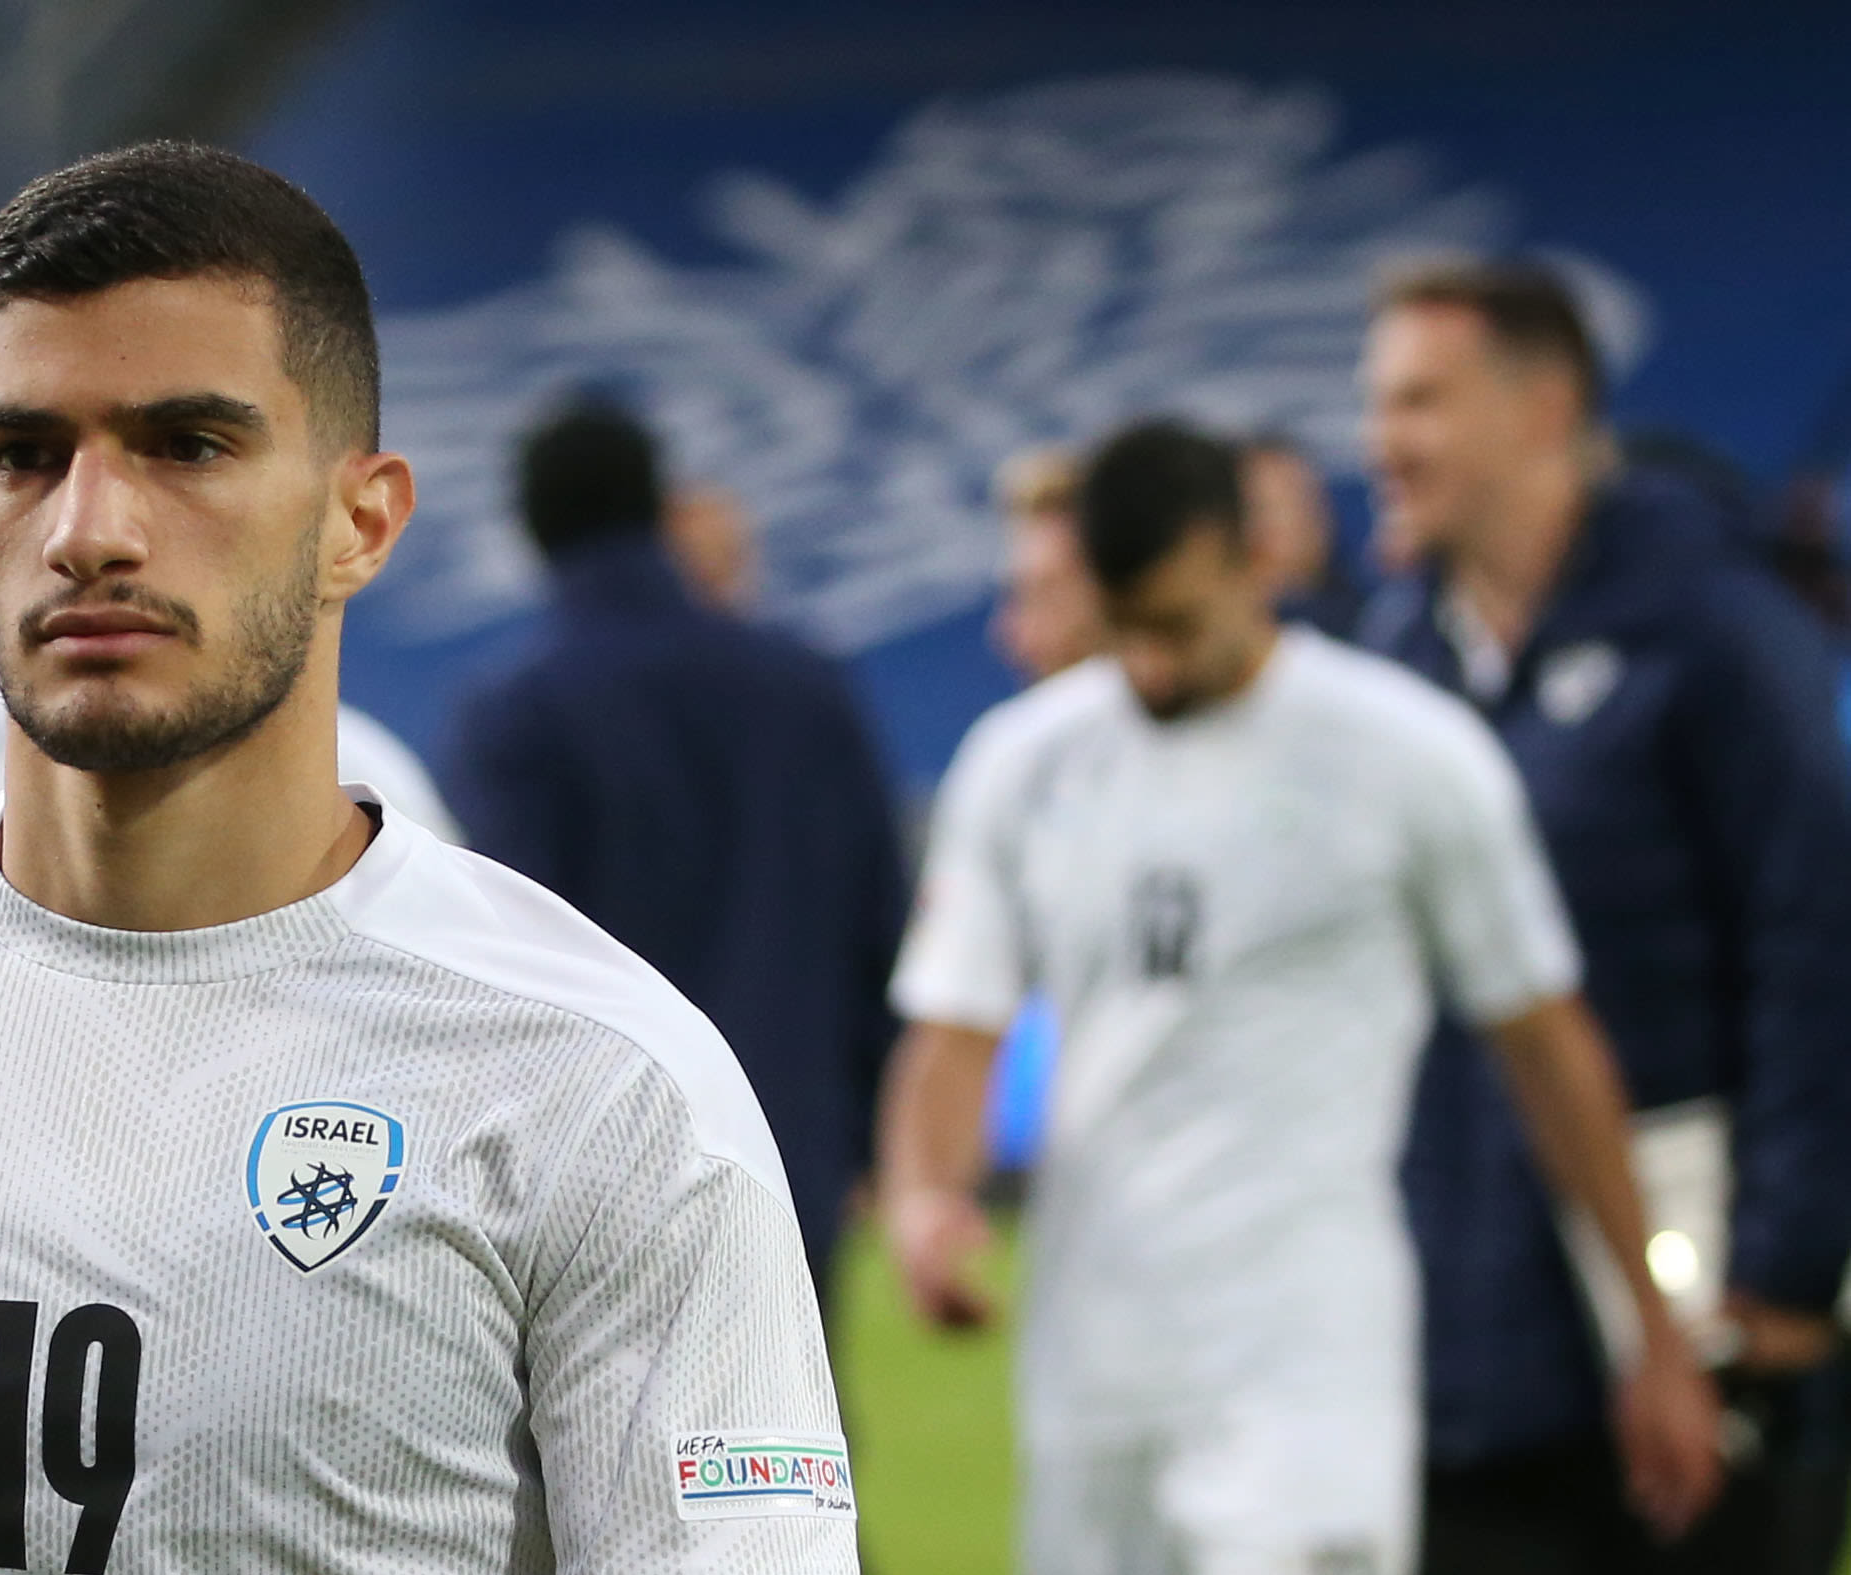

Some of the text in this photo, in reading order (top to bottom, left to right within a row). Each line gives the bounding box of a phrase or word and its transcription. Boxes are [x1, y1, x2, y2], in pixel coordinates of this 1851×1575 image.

[283, 1115, 379, 1146] ISRAEL
[677, 1436, 726, 1455] UEFA
[678, 1456, 849, 1489] FOUNDATION
